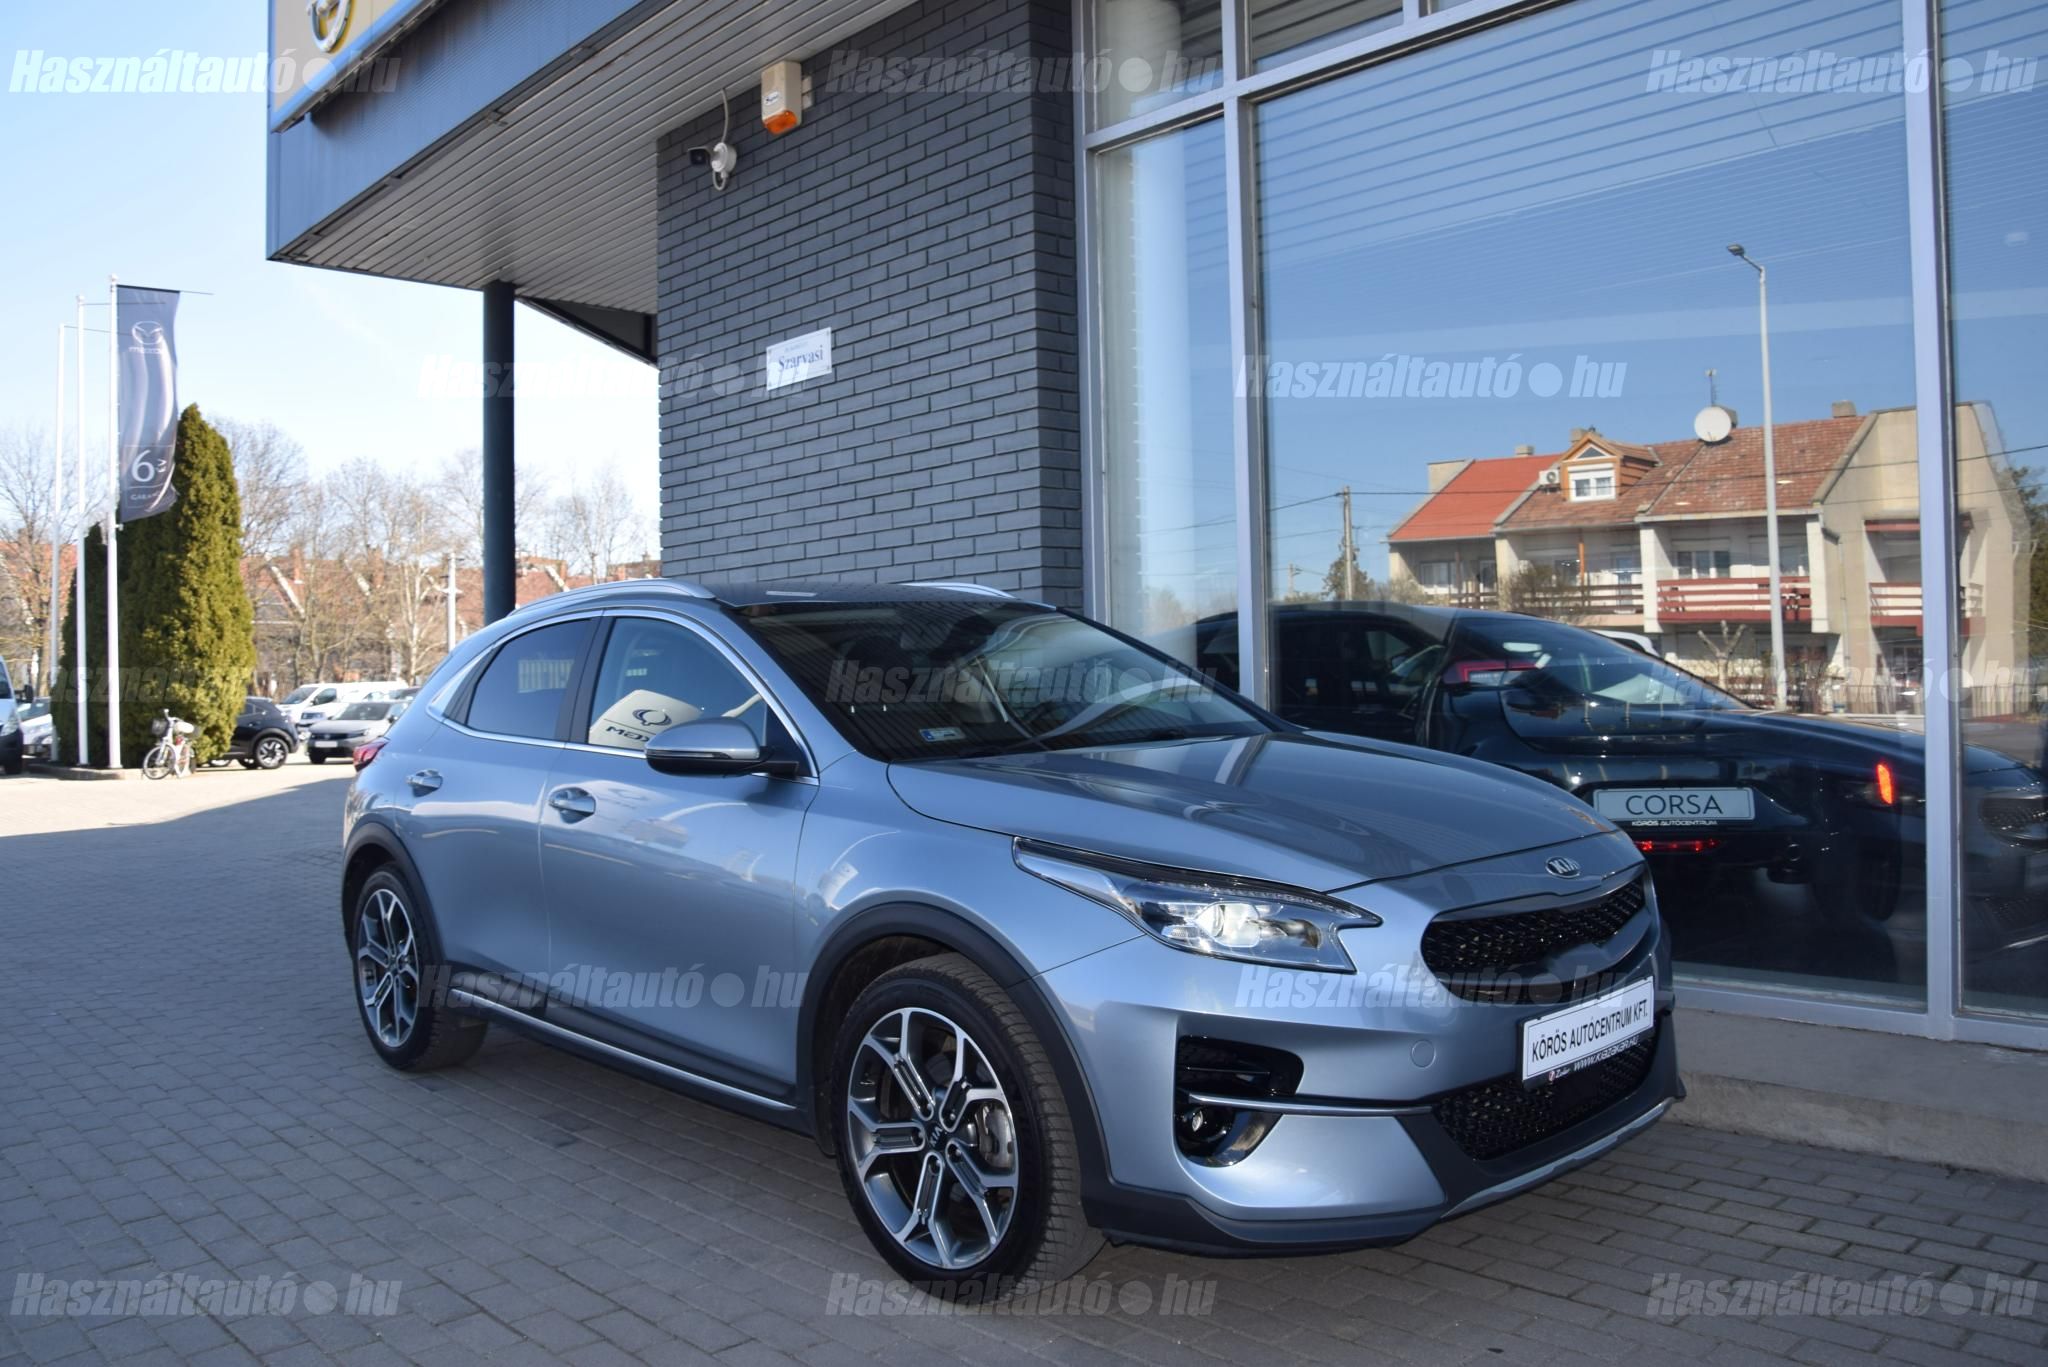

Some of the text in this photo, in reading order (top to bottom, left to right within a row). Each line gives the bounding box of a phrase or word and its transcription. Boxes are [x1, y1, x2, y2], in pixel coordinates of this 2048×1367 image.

[778, 345, 824, 371] Szarvasi
[132, 450, 154, 482] 6
[1626, 795, 1723, 815] CORSA
[1549, 858, 1579, 874] KIA
[1569, 1006, 1633, 1049] AUTÓCENTRUM
[1633, 999, 1649, 1023] KFT.
